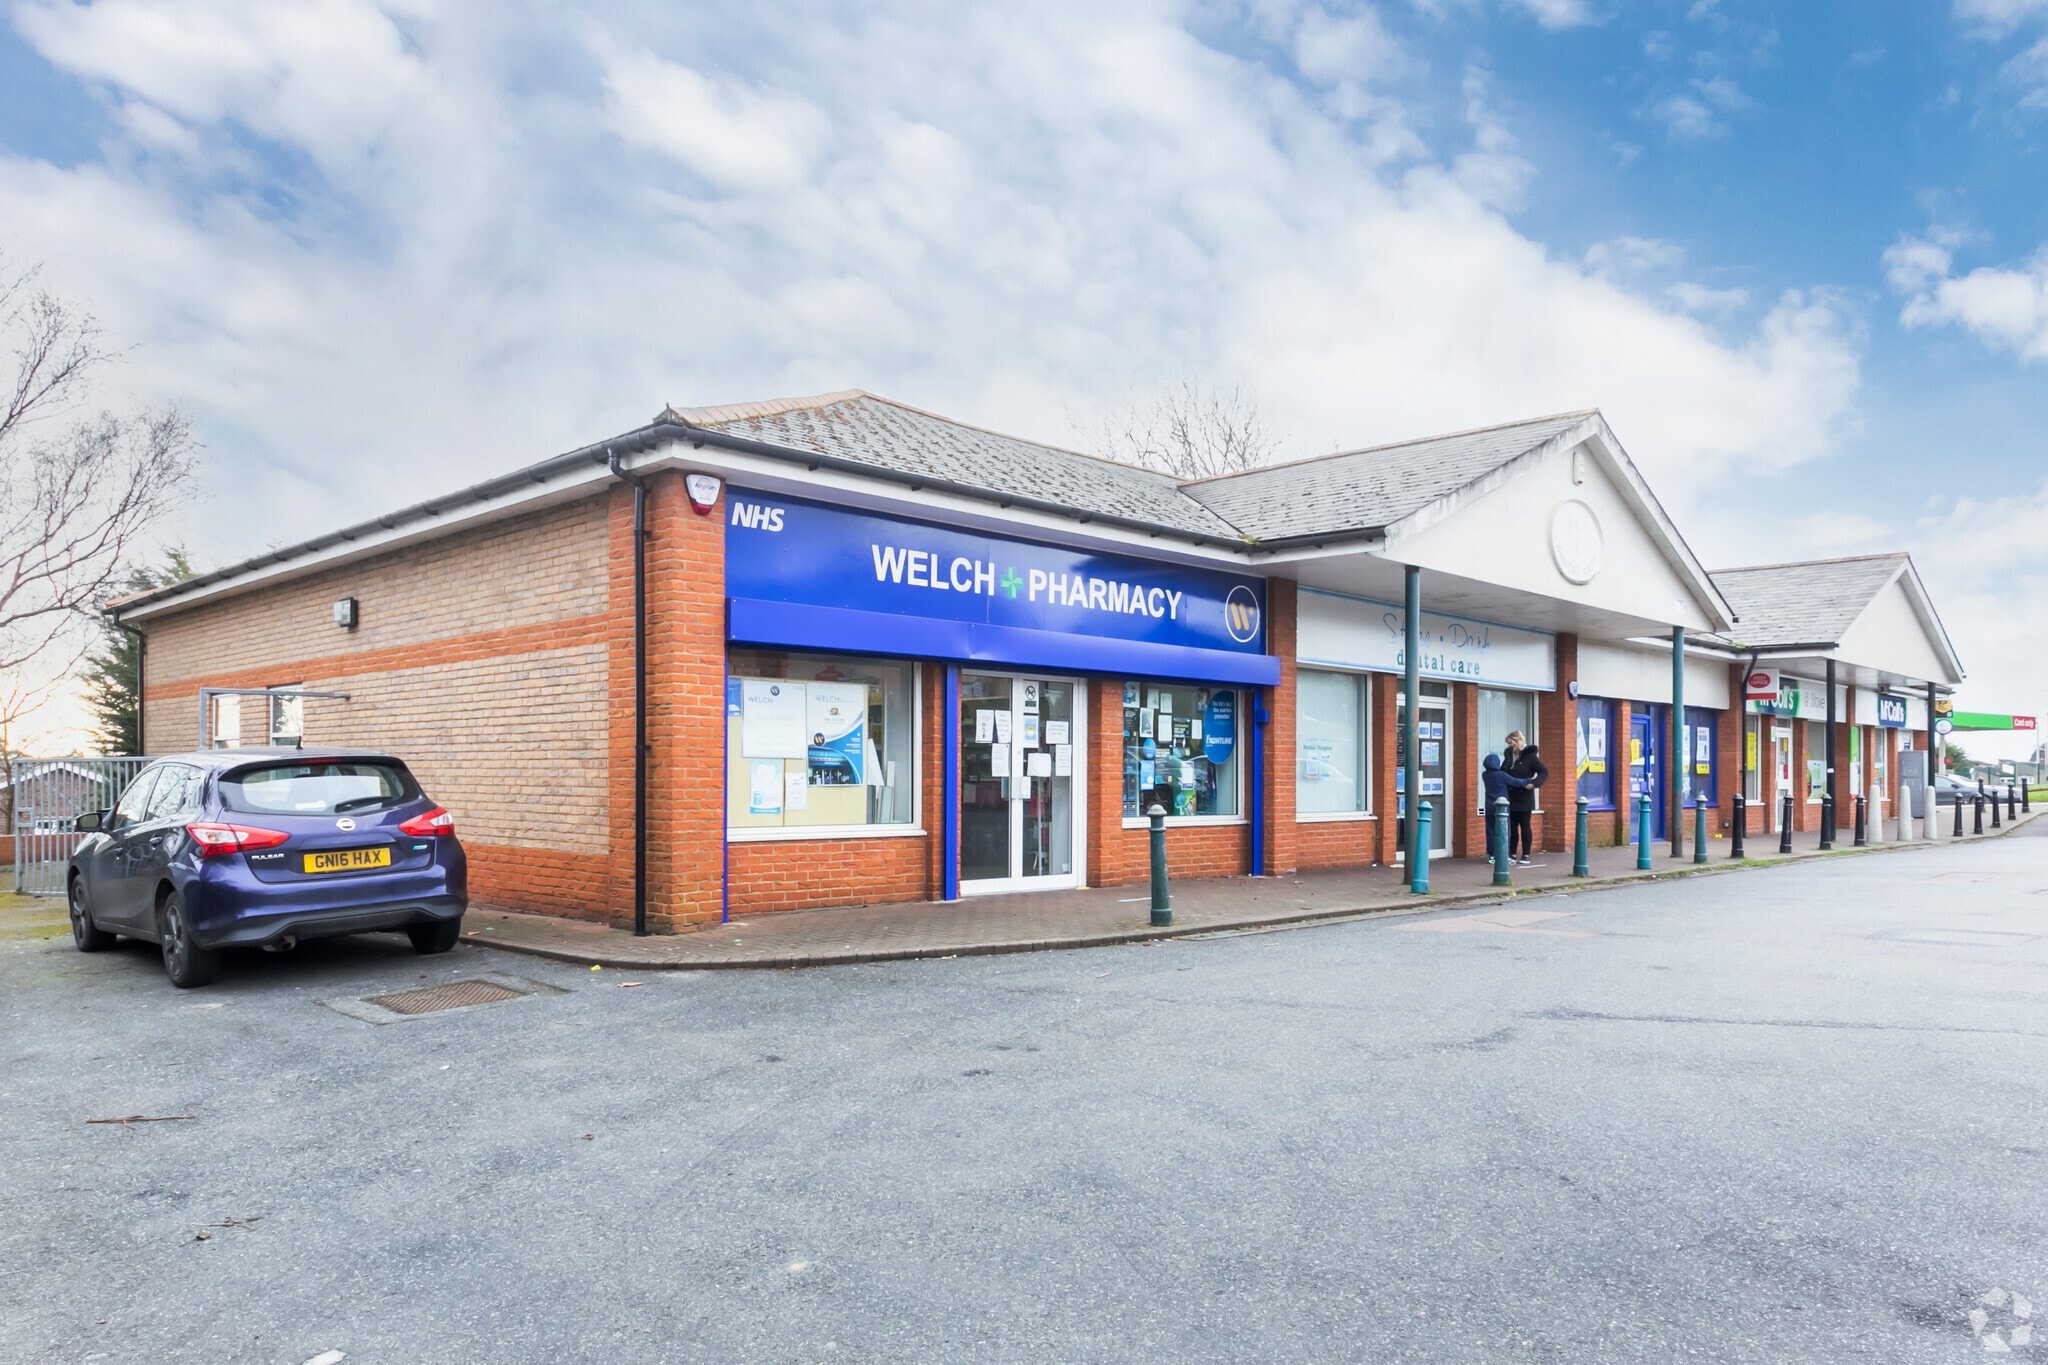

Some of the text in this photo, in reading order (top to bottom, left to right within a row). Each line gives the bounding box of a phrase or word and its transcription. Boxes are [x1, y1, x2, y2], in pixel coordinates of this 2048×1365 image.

[731, 502, 785, 532] NHS
[872, 544, 1183, 620] WELCH PHARMACY
[1450, 660, 1480, 676] care
[748, 696, 774, 704] WELCH
[815, 695, 840, 703] WELCH
[2014, 718, 2035, 728] Card only
[251, 853, 285, 861] PULSAR
[315, 850, 382, 869] GN16 HAX
